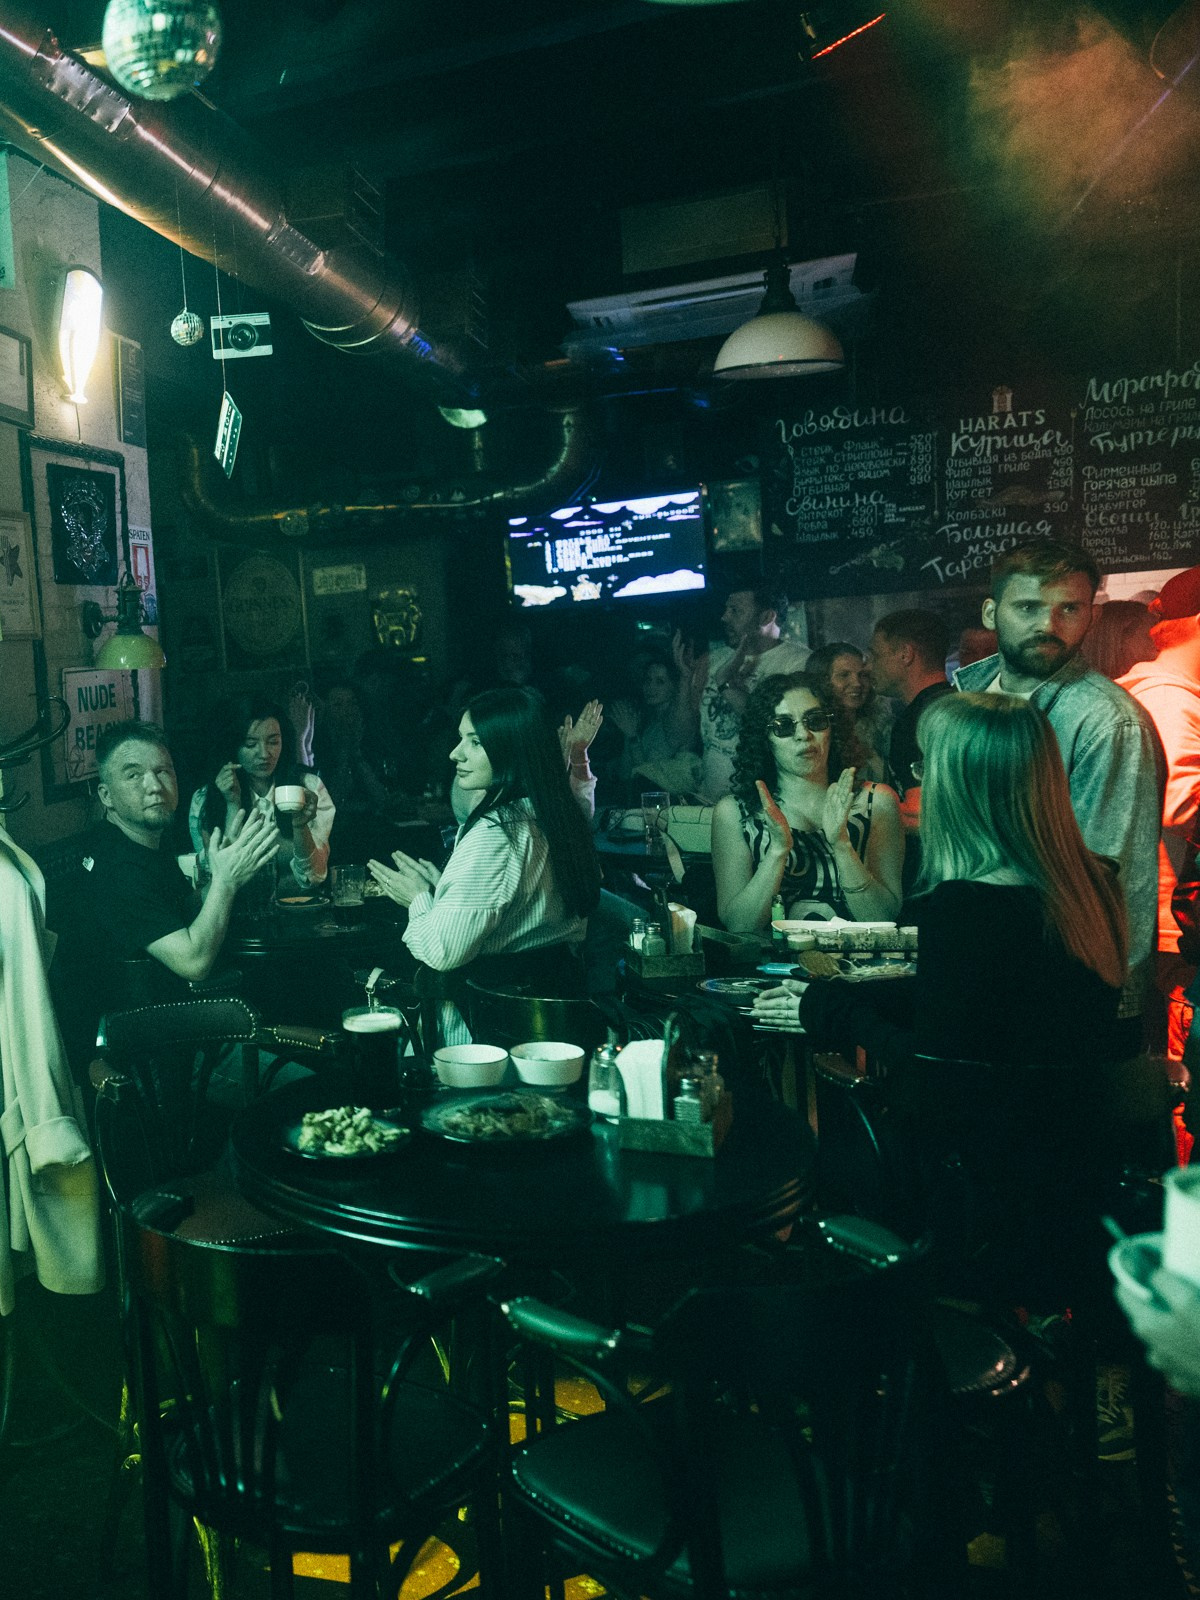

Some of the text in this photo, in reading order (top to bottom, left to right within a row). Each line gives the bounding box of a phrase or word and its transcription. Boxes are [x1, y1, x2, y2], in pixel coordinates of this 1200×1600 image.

[959, 409, 1045, 434] HARATS
[951, 429, 1069, 458] Курица
[1043, 501, 1069, 513] 390
[129, 528, 150, 541] SPATEN
[935, 519, 1053, 545] Большая
[1085, 545, 1128, 557] оматы
[77, 683, 117, 714] NUDE
[75, 721, 120, 751] BEA
